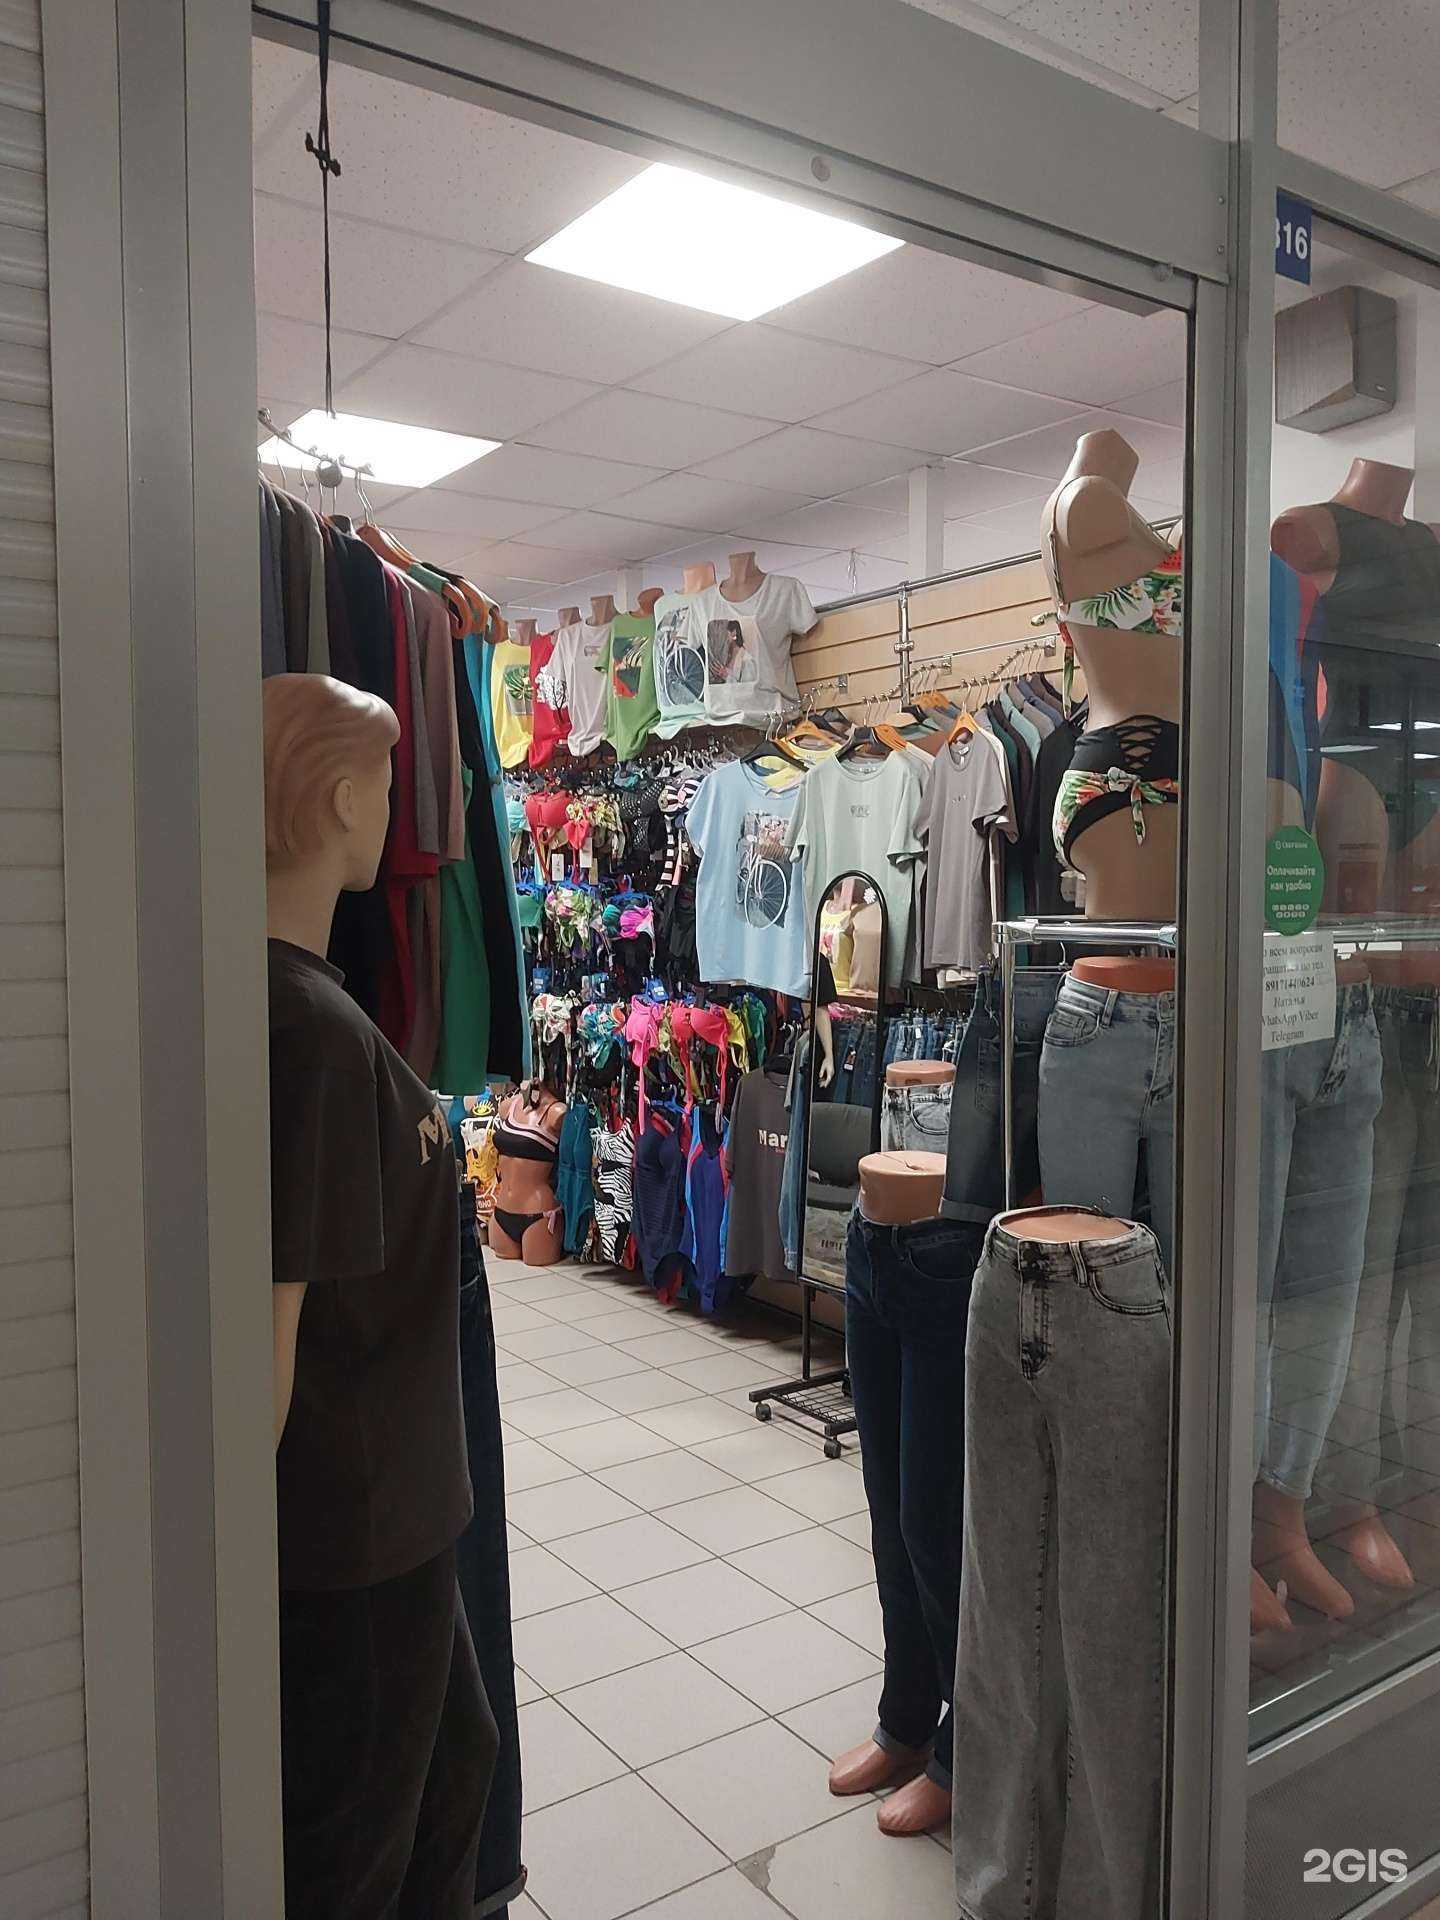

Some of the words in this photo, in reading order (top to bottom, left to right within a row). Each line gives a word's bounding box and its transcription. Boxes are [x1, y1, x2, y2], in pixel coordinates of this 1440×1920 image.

[1266, 865, 1316, 876] Оплачивайте
[1270, 882, 1284, 890] как
[1285, 880, 1312, 892] удобно
[1271, 1030, 1305, 1043] Telegram
